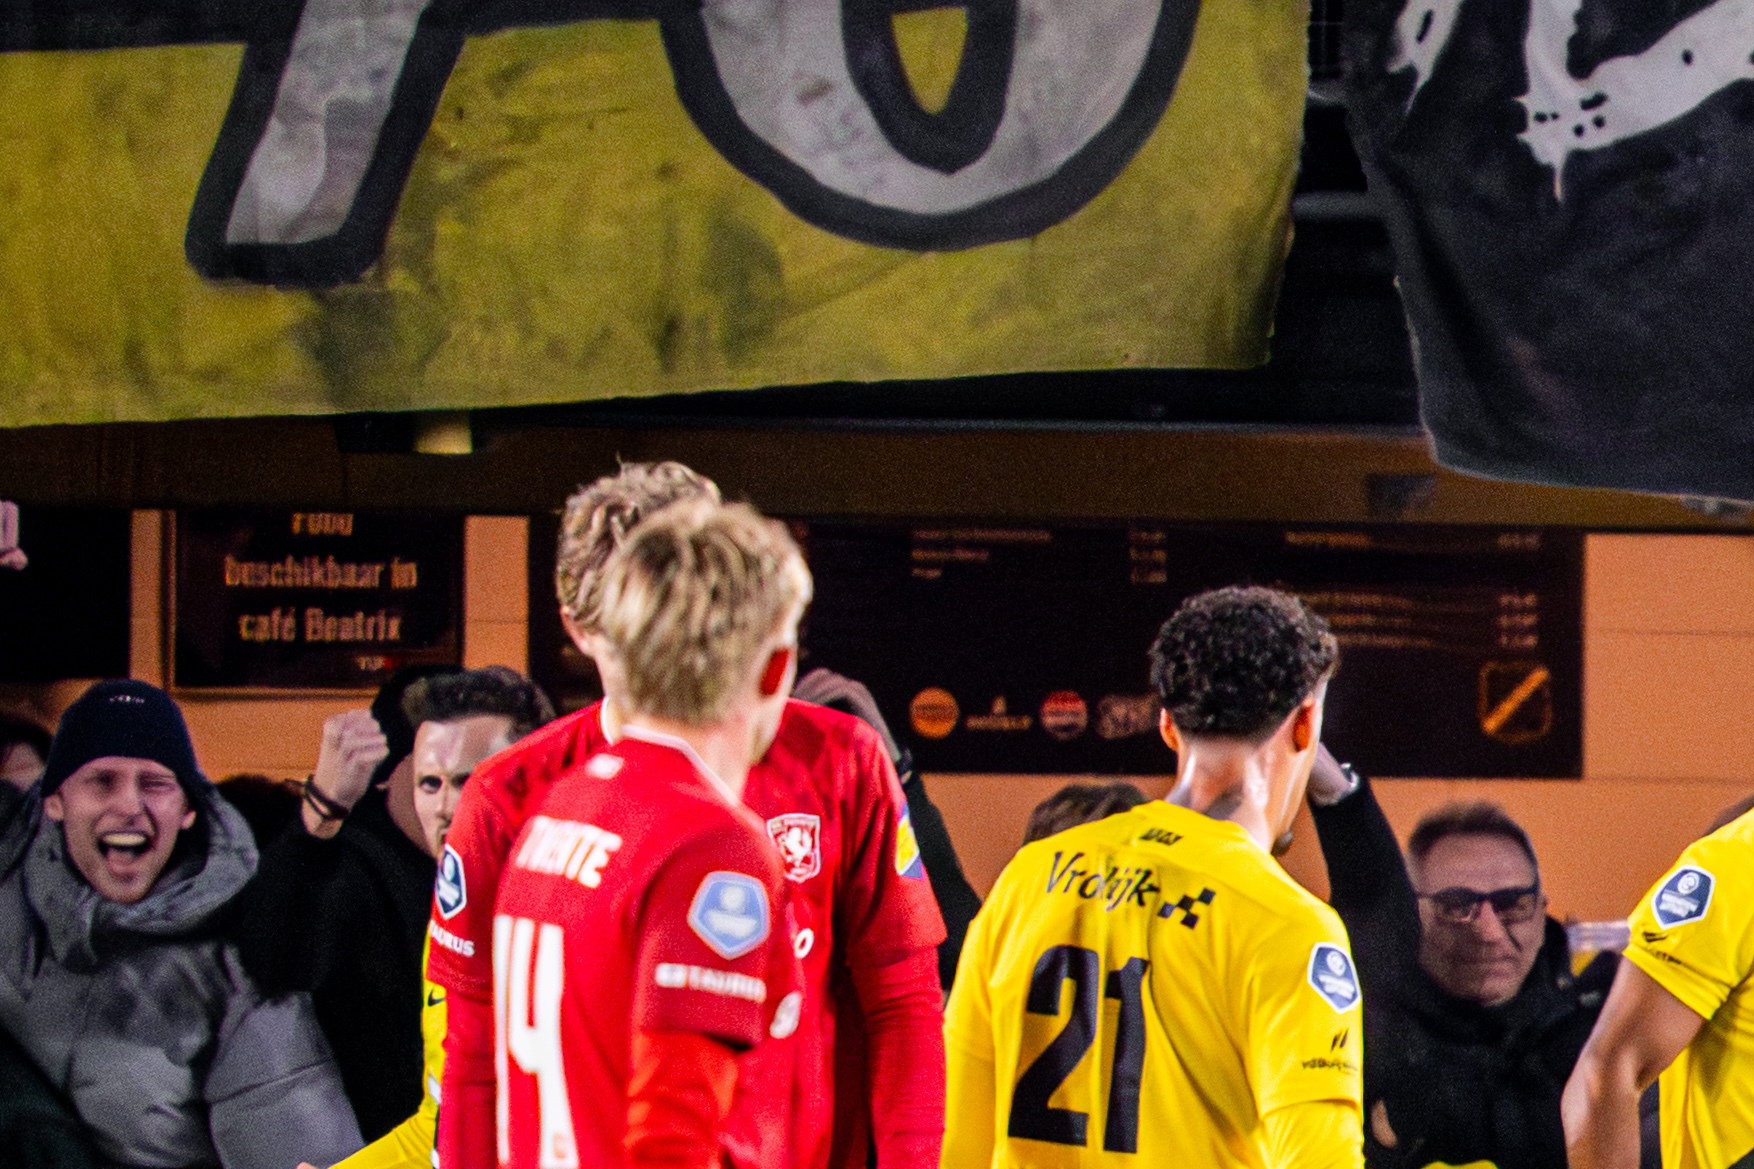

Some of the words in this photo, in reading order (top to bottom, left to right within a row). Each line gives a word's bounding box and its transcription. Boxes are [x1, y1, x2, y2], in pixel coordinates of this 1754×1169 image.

[224, 553, 384, 587] beschikbaar
[390, 556, 417, 589] in
[237, 606, 296, 641] café
[304, 607, 401, 641] Beatrix
[1046, 850, 1161, 912] Vrolijk
[1008, 944, 1151, 1153] 21
